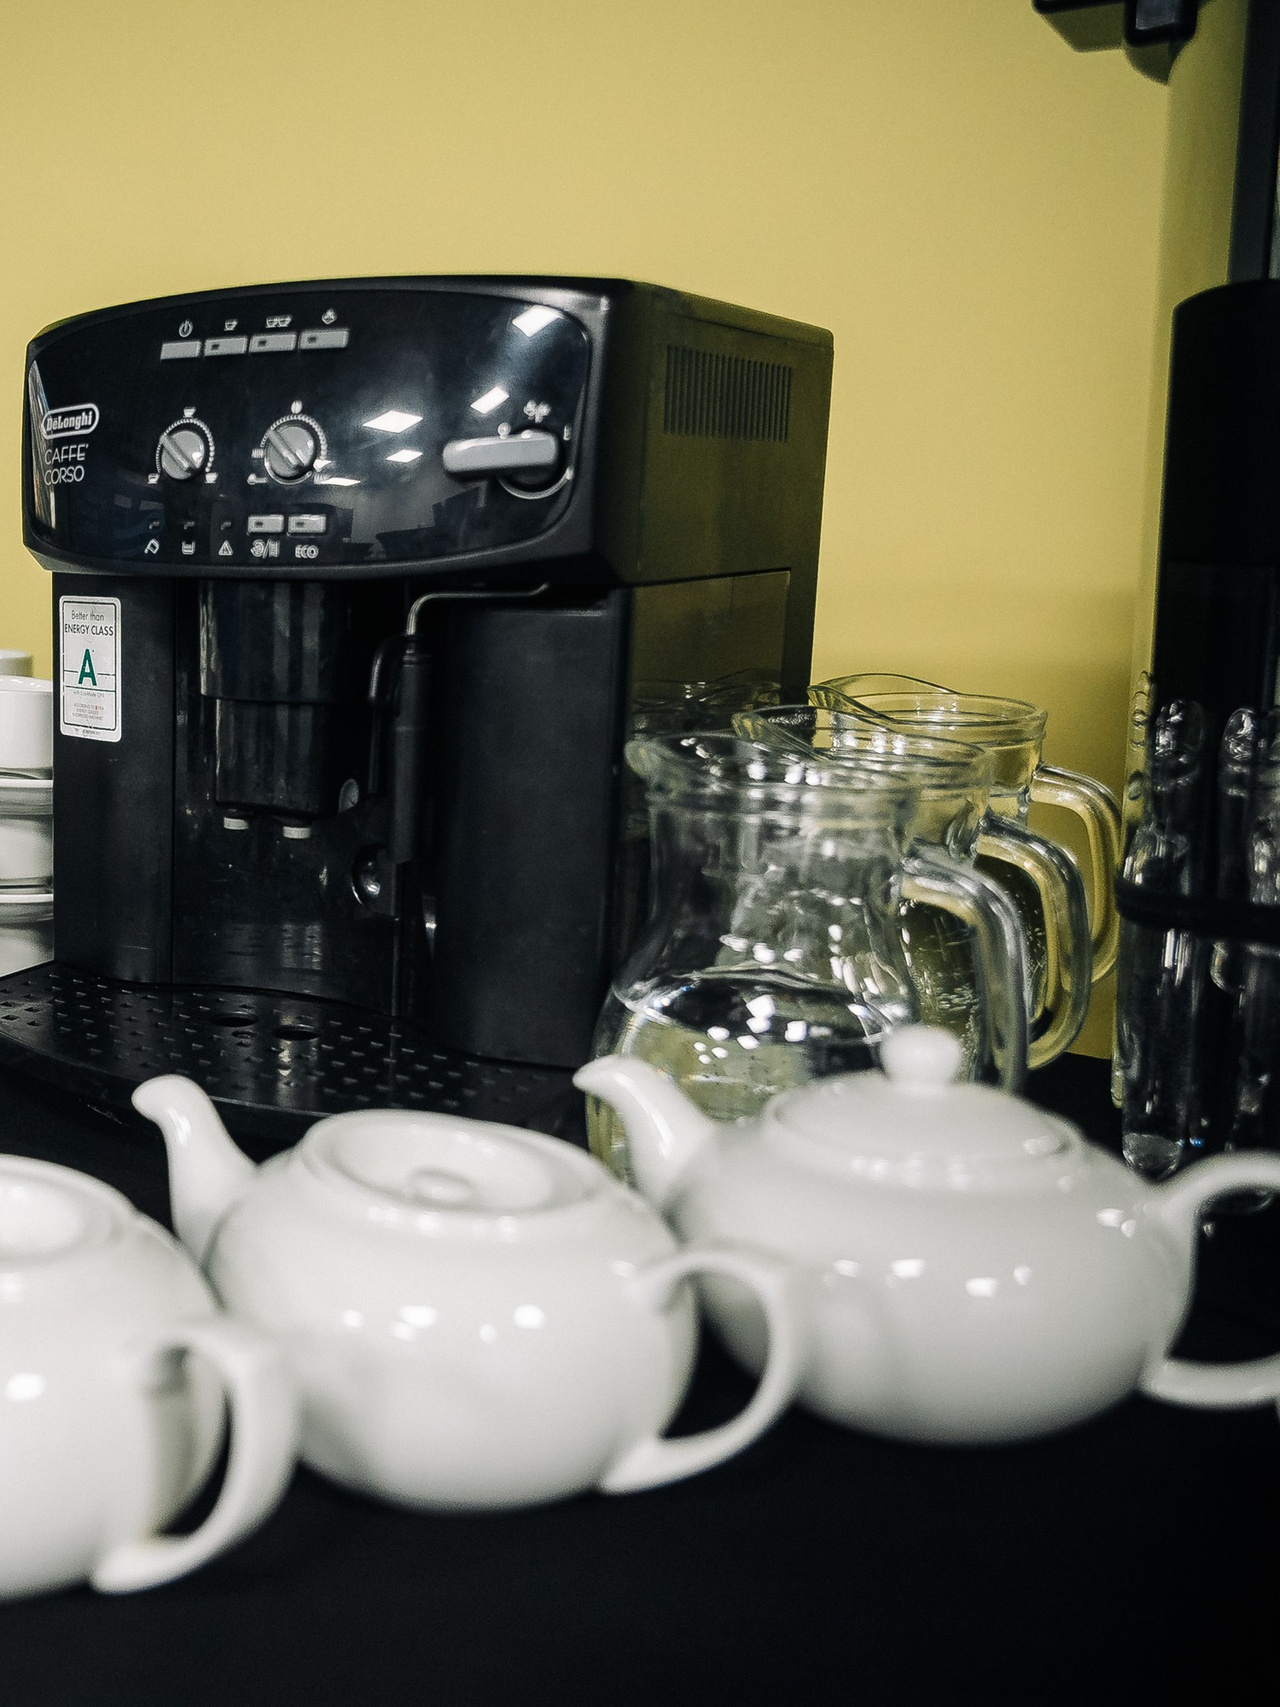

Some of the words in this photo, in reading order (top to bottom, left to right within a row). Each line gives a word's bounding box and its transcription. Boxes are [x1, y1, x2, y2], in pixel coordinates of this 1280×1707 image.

[44, 465, 85, 486] CORSO
[295, 544, 319, 559] ECO
[71, 609, 89, 621] Better
[90, 609, 105, 622] than
[64, 623, 90, 635] ENERGY
[91, 625, 114, 637] CLASS
